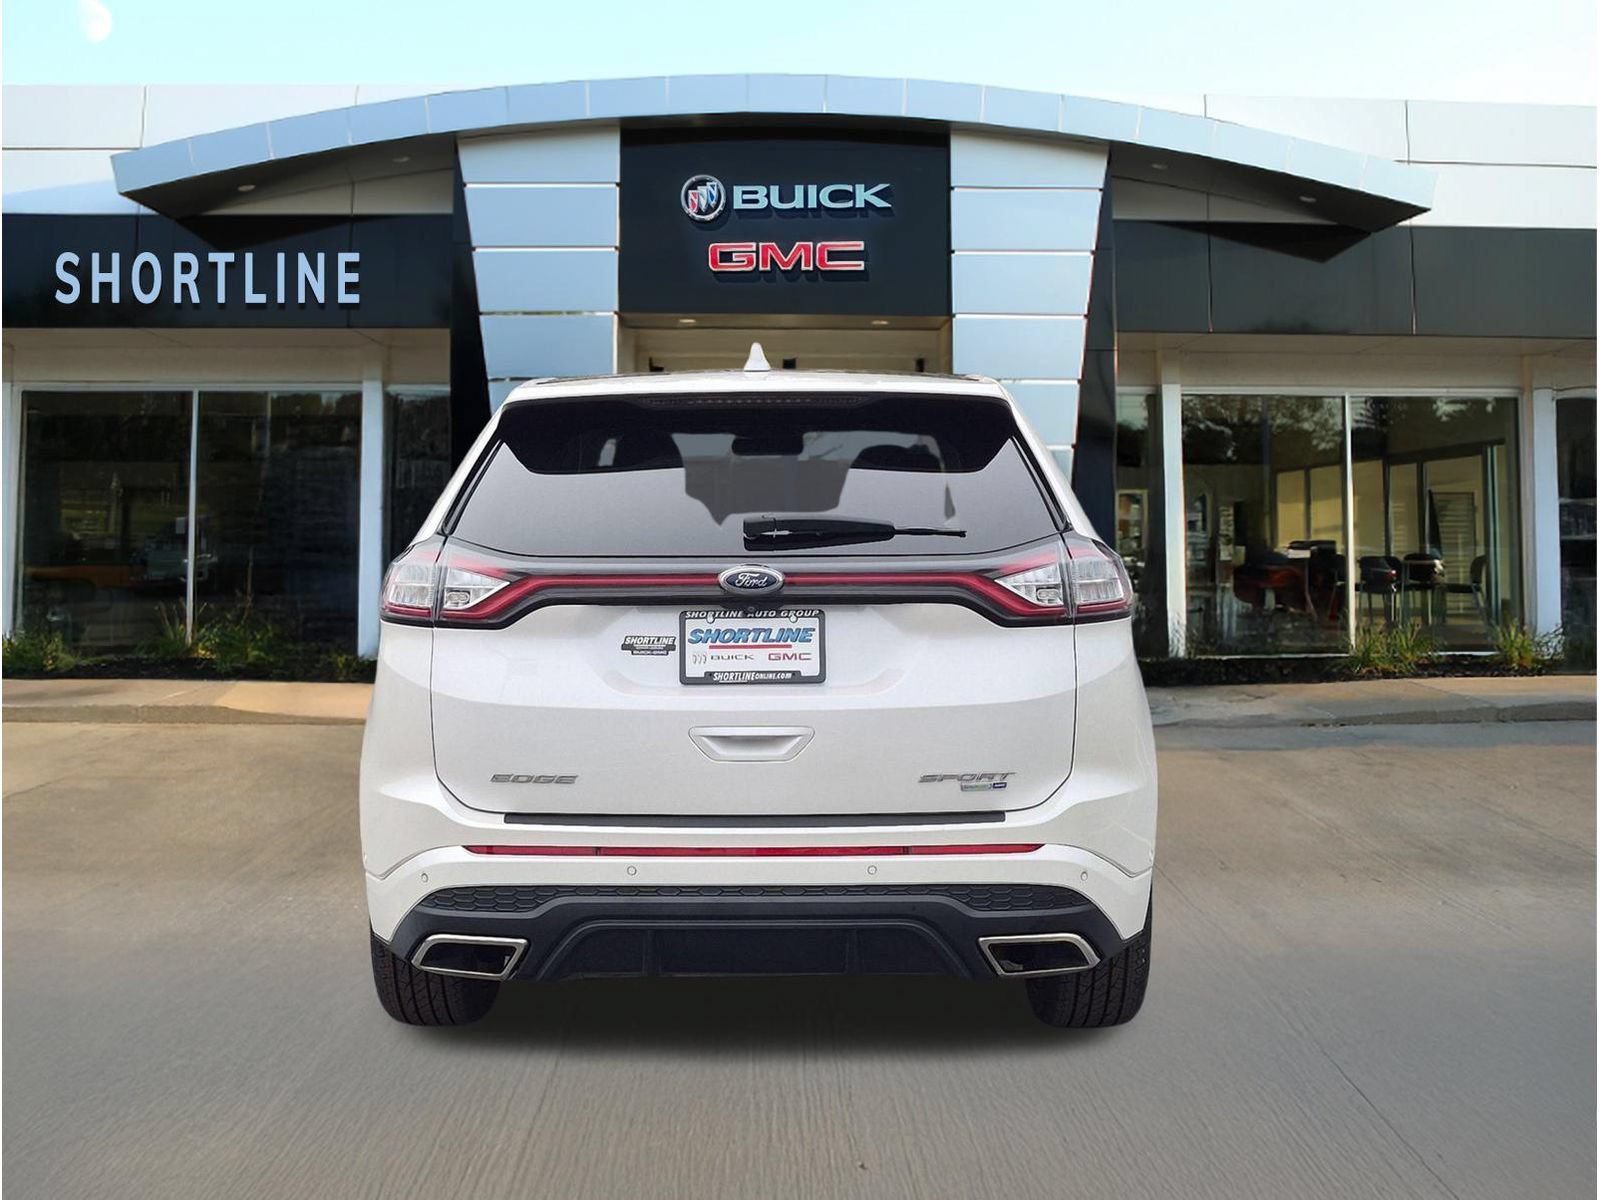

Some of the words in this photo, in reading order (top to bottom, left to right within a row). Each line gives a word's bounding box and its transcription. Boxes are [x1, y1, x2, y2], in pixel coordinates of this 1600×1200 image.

[733, 183, 892, 210] BUICK
[709, 241, 865, 272] GMC
[54, 251, 360, 305] SHORTLINE
[735, 572, 768, 587] Ford
[685, 610, 743, 618] SHORTLINE
[780, 609, 820, 618] GROUP
[624, 636, 675, 645] SHORTLINE
[687, 628, 816, 644] SHORTLINE
[710, 653, 755, 661] BUICK
[767, 652, 812, 661] GMC
[489, 773, 579, 785] EDGE
[918, 772, 1017, 783] SPORT
